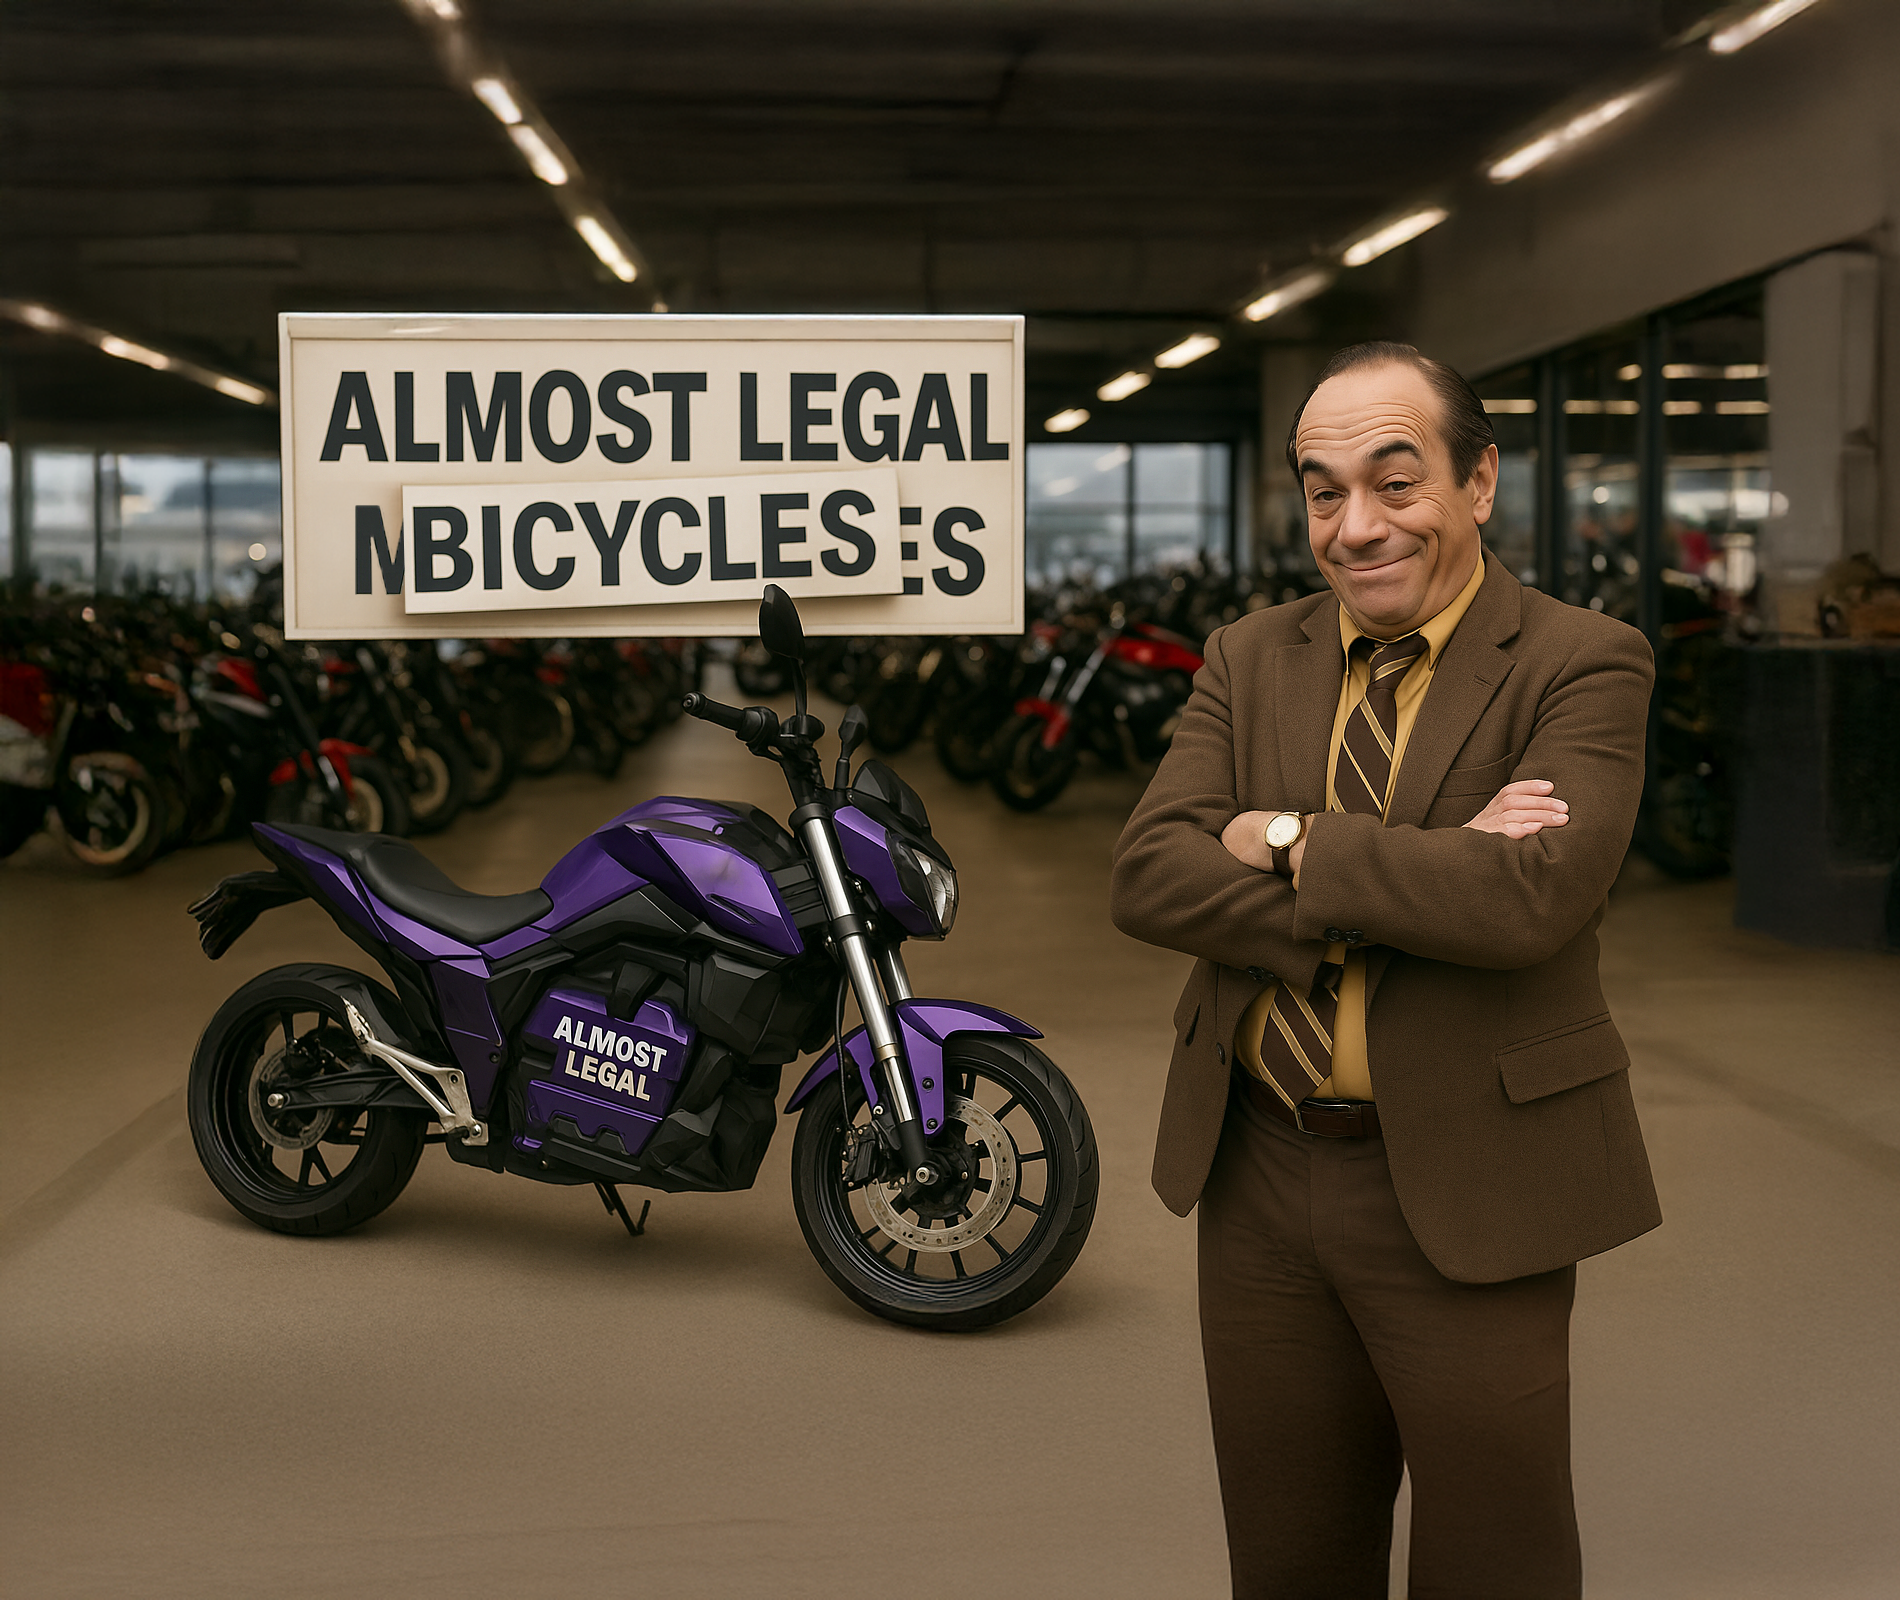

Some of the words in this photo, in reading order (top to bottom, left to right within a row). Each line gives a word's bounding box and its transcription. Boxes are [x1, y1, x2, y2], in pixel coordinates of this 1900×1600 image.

[319, 369, 708, 463] ALMOST
[739, 370, 1010, 463] LEGAL
[412, 489, 877, 594] BICYCLES
[552, 1015, 668, 1073] ALMOST
[564, 1049, 651, 1102] LEGAL
